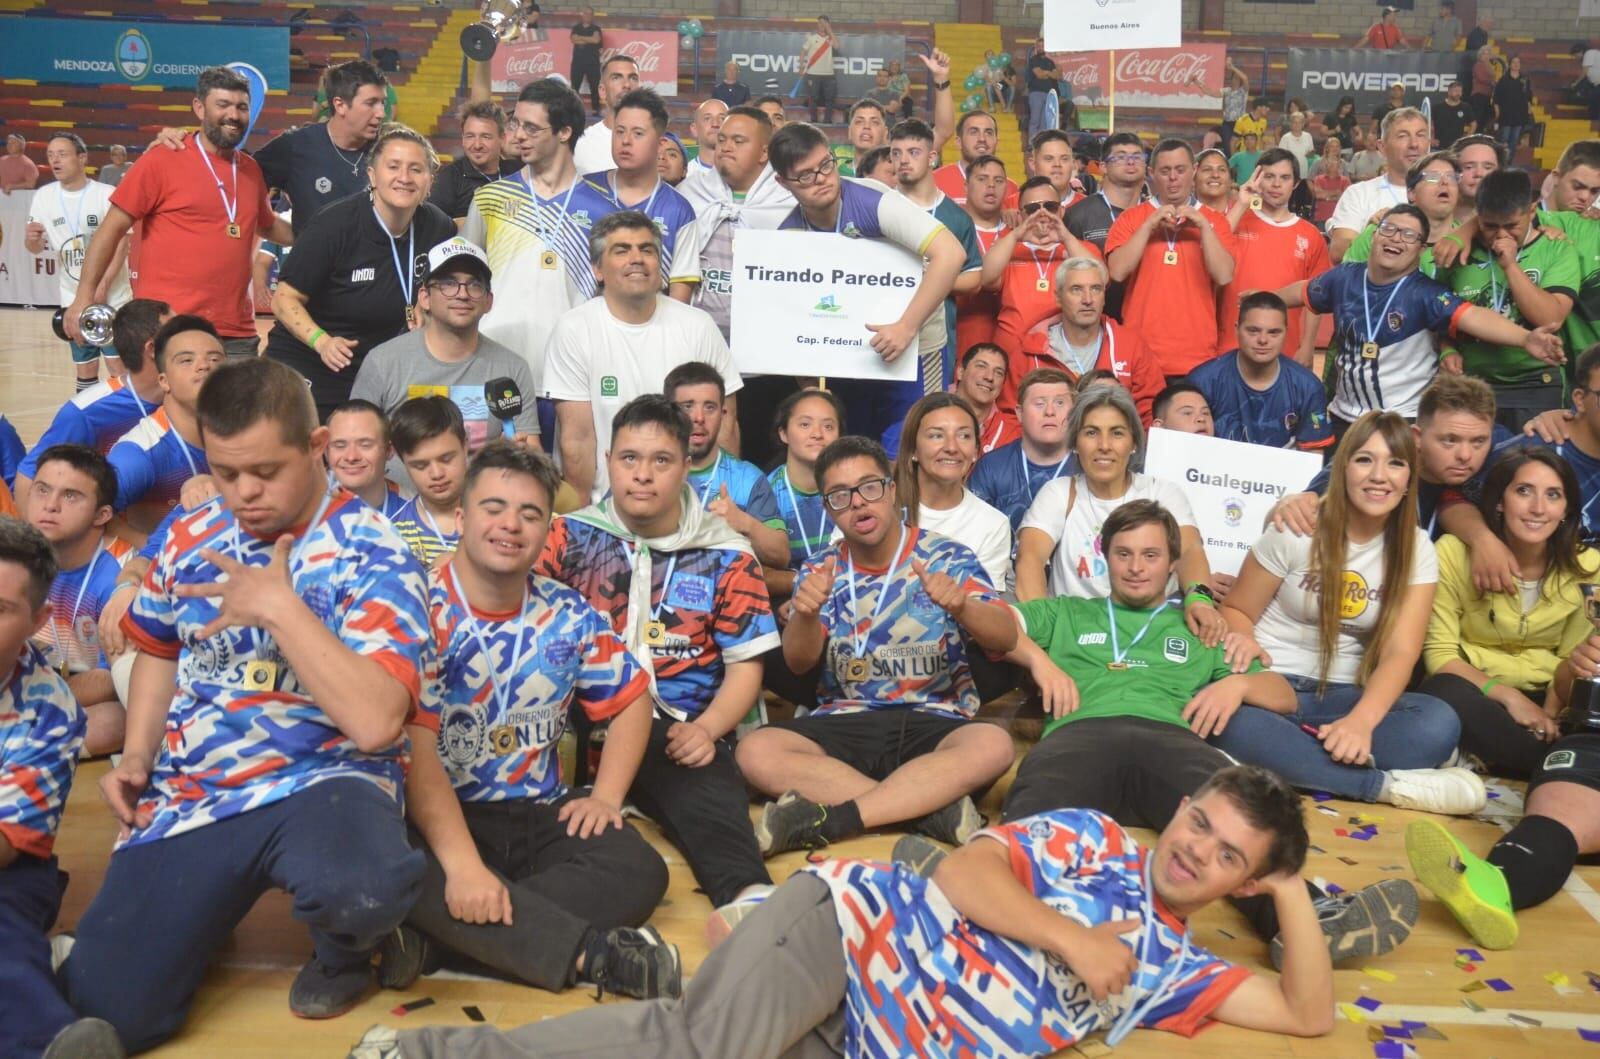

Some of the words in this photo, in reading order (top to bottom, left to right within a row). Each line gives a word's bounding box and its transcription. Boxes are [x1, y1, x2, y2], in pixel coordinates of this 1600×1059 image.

[54, 59, 116, 72] MENDOZA
[1116, 51, 1213, 84] Coca-Cola
[1302, 71, 1457, 92] POWERADE
[352, 268, 375, 282] UNDO
[745, 265, 824, 284] Tirando
[831, 269, 916, 288] Paredes
[796, 335, 820, 346] Cap.
[823, 337, 863, 346] Federal
[1186, 468, 1287, 499] Gualeguay
[1207, 537, 1234, 548] Entre
[880, 646, 924, 658] GOBIERNO
[926, 644, 938, 655] DE
[872, 658, 906, 677] SAN
[912, 652, 949, 676] LUIS
[507, 708, 550, 724] OBIERNO
